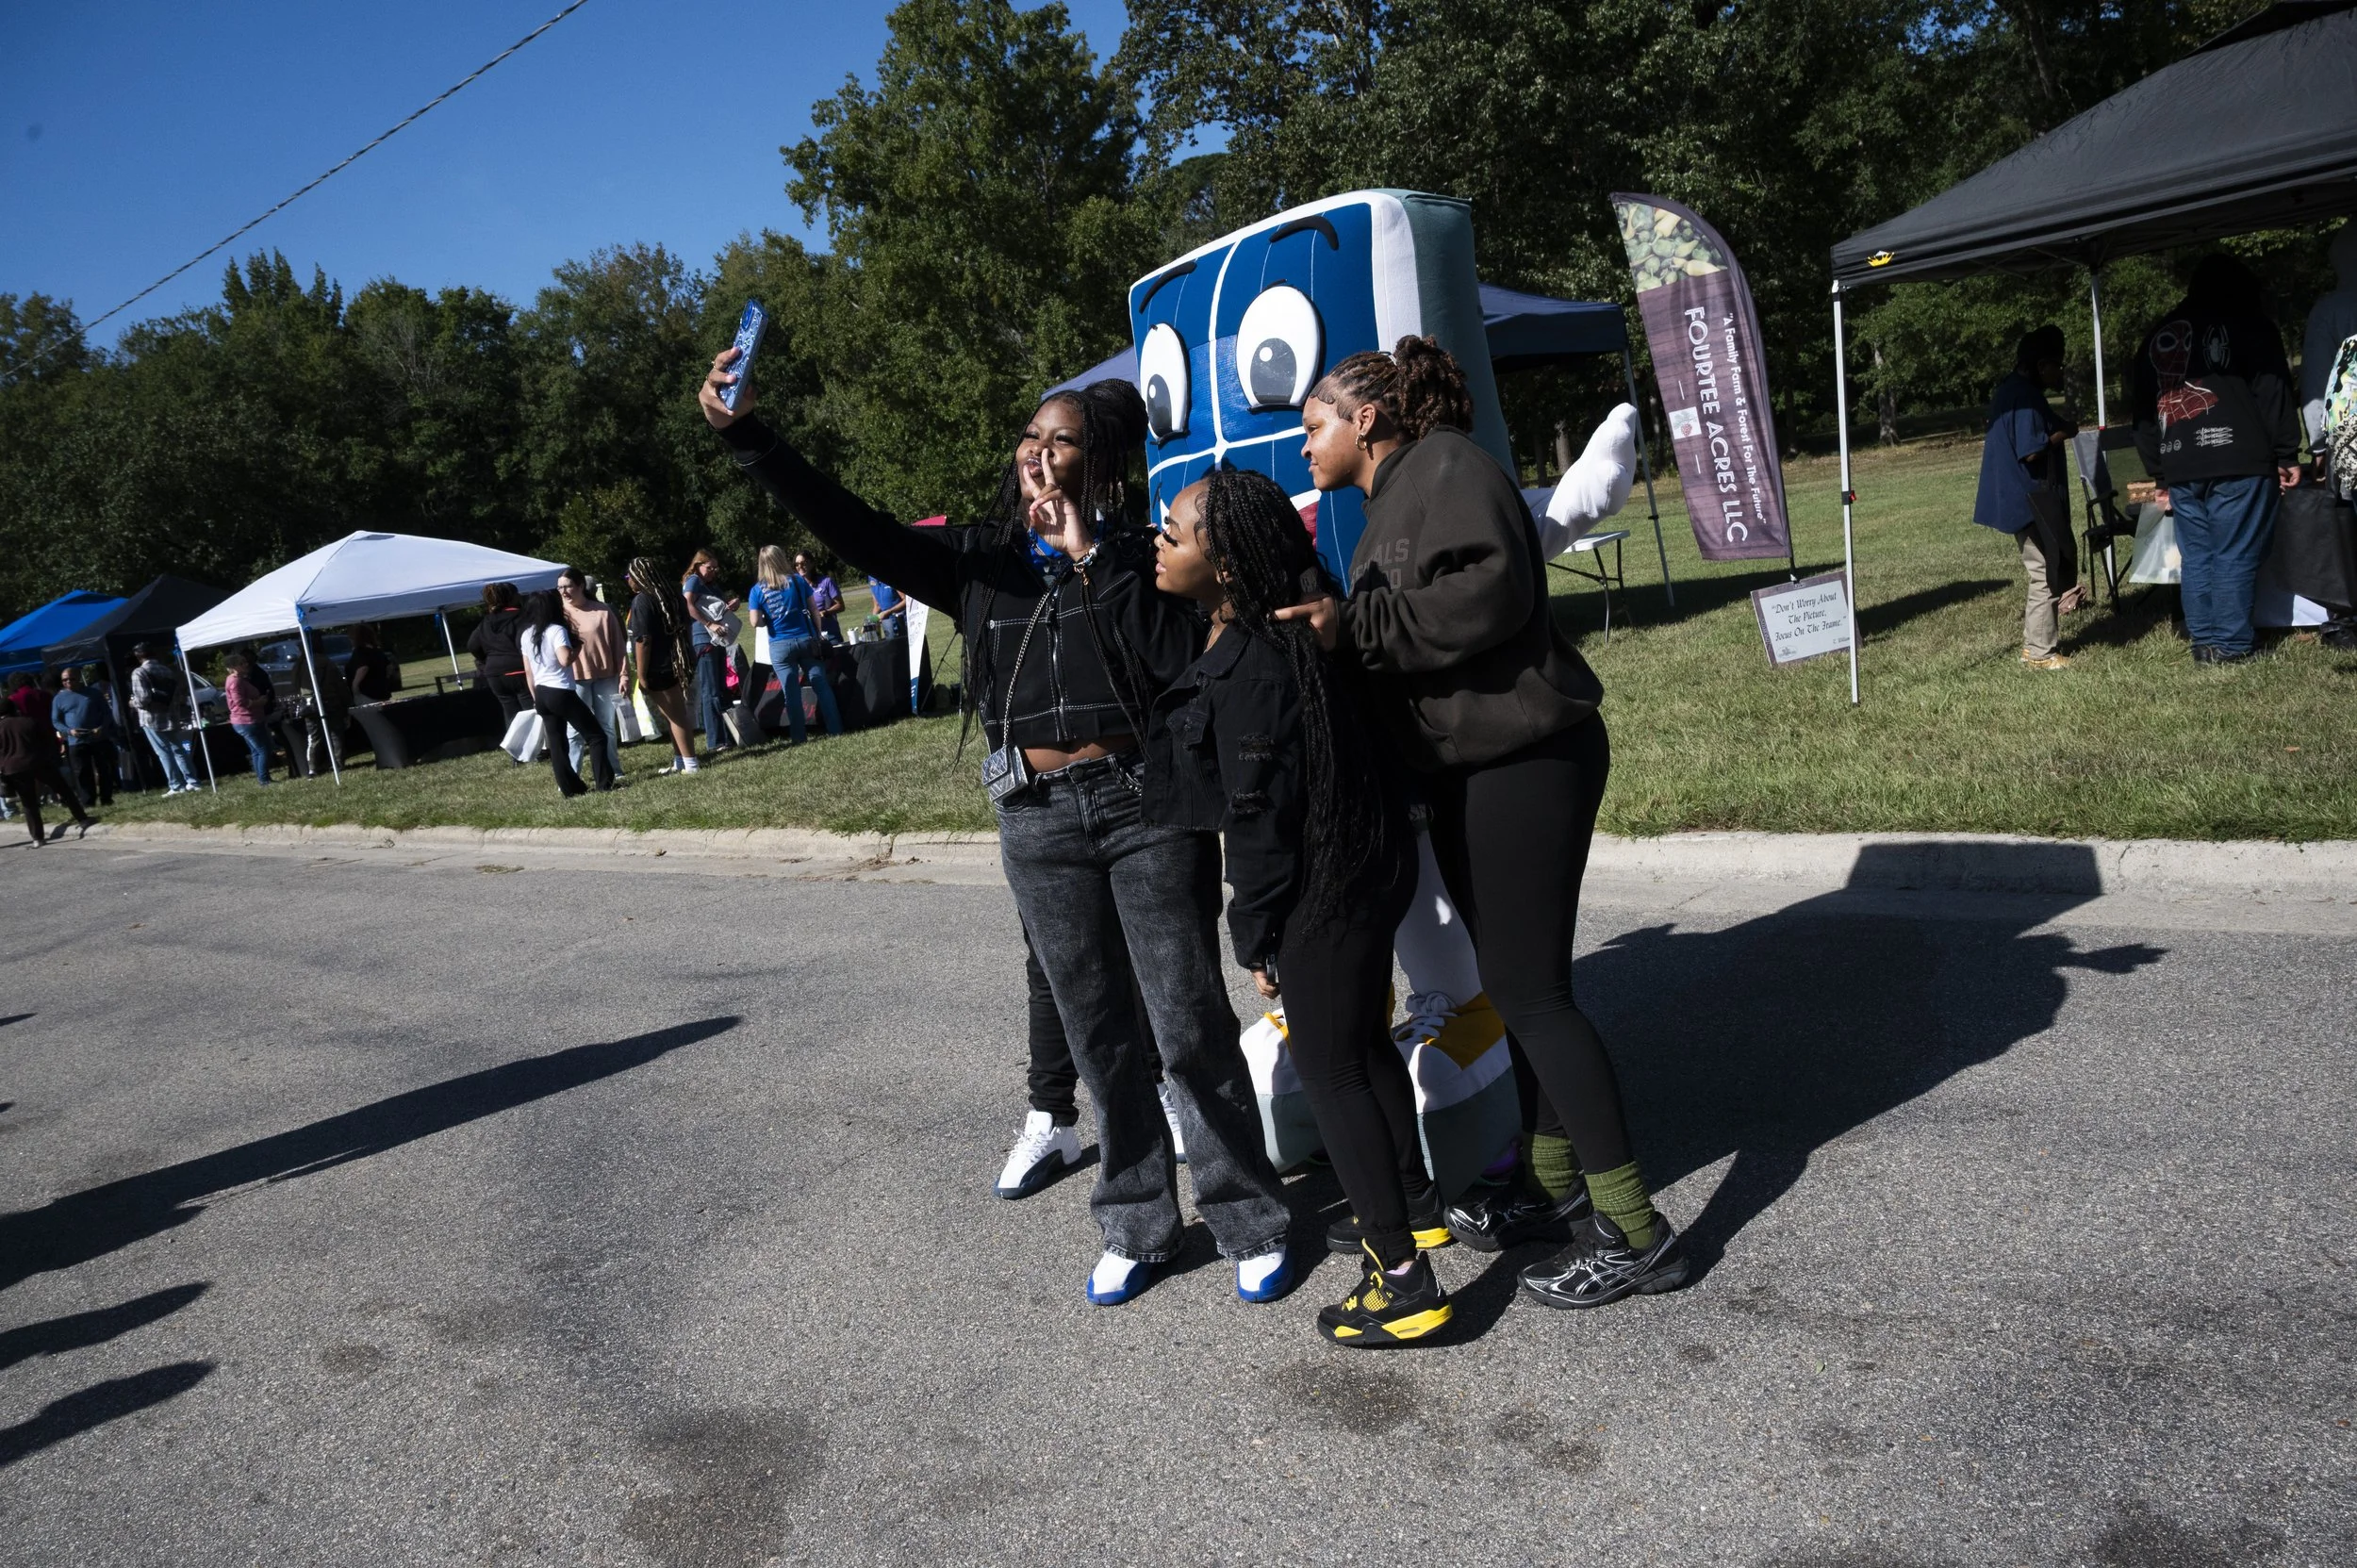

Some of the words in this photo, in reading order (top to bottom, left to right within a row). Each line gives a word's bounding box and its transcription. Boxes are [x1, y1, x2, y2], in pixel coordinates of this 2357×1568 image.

[1725, 328, 1739, 364] Family
[1731, 366, 1742, 394] Farm
[1736, 397, 1746, 406] &
[1684, 306, 1721, 415] FOURTEE
[1706, 421, 1737, 493] ACRES
[1722, 500, 1748, 543] LLC
[1738, 409, 1751, 442] Forest
[1743, 445, 1754, 463] For
[1746, 465, 1757, 485] The
[1796, 598, 1816, 608] Worry
[1818, 592, 1837, 605] About
[1788, 615, 1801, 624] The
[1775, 632, 1792, 641] Focus
[1794, 627, 1805, 636] On
[1806, 624, 1820, 634] The
